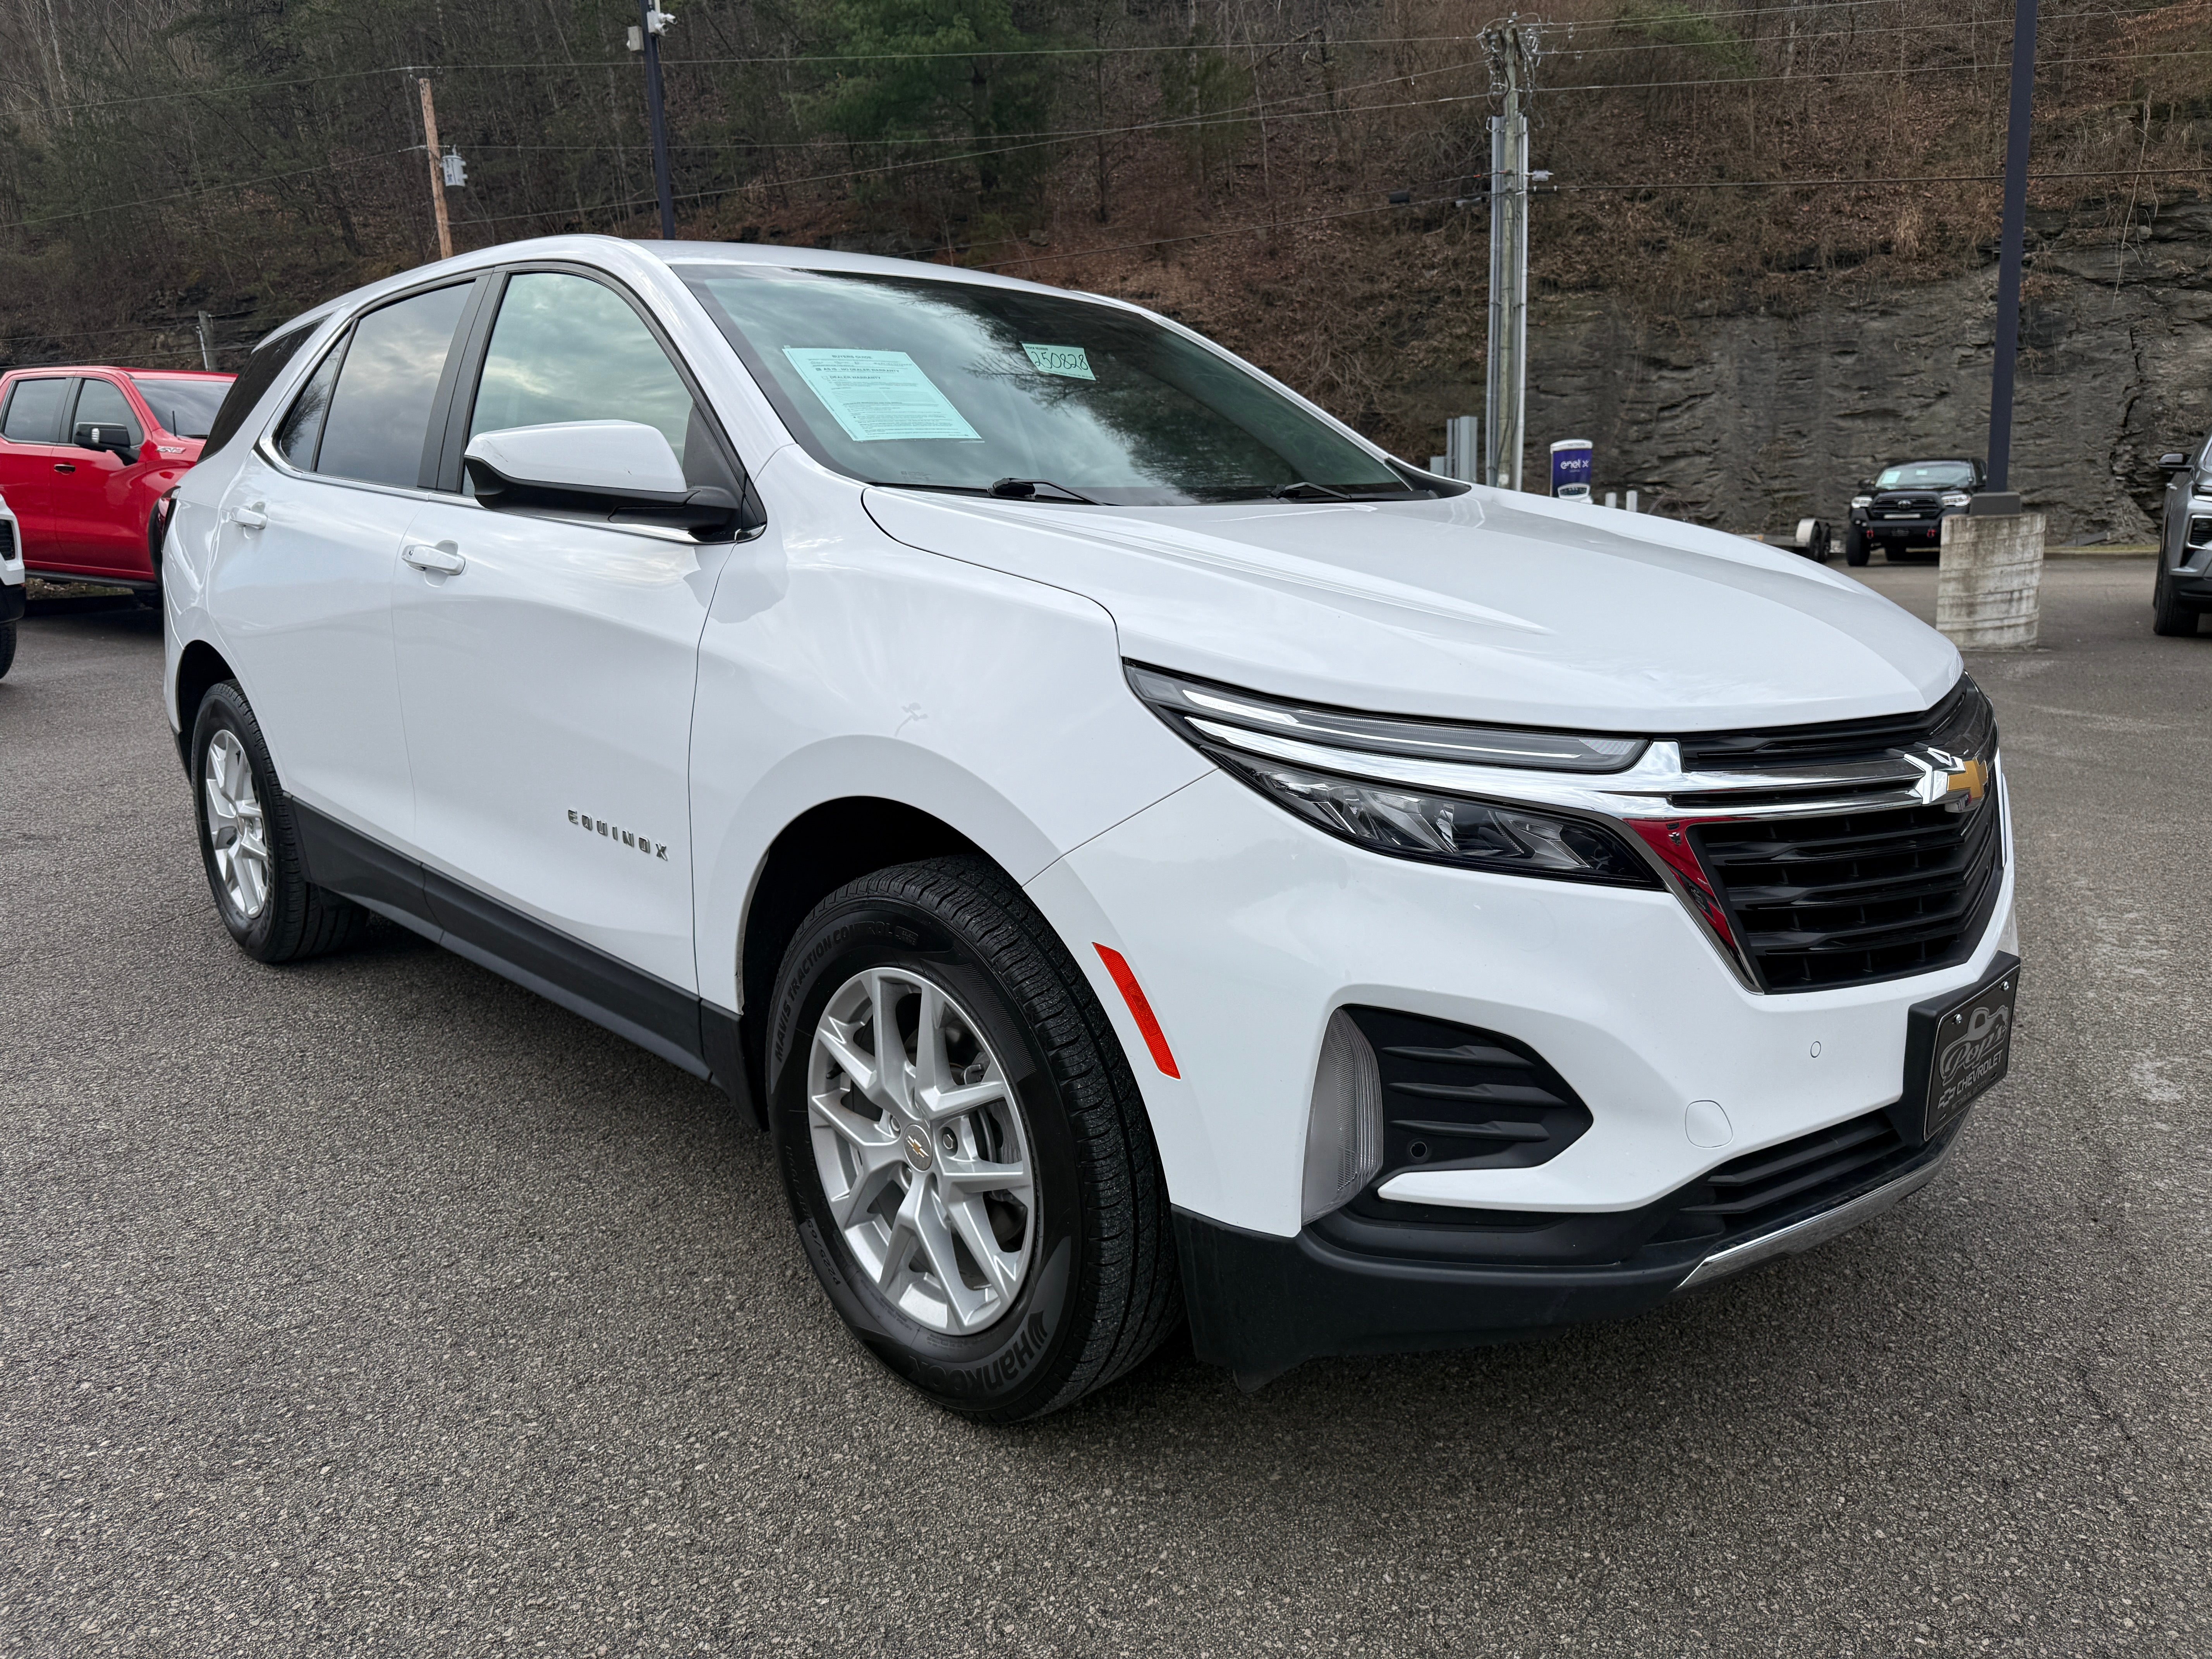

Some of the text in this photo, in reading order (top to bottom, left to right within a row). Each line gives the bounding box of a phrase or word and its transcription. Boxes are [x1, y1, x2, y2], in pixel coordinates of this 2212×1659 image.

[1031, 351, 1089, 371] 250828
[1560, 459, 1582, 470] enel
[568, 808, 668, 862] EQUINOX
[775, 1000, 792, 1063] MAVIS
[787, 934, 833, 1002] TRACTION
[1957, 1049, 2003, 1095] CHEVROLET
[908, 1329, 1035, 1392] Hankook
